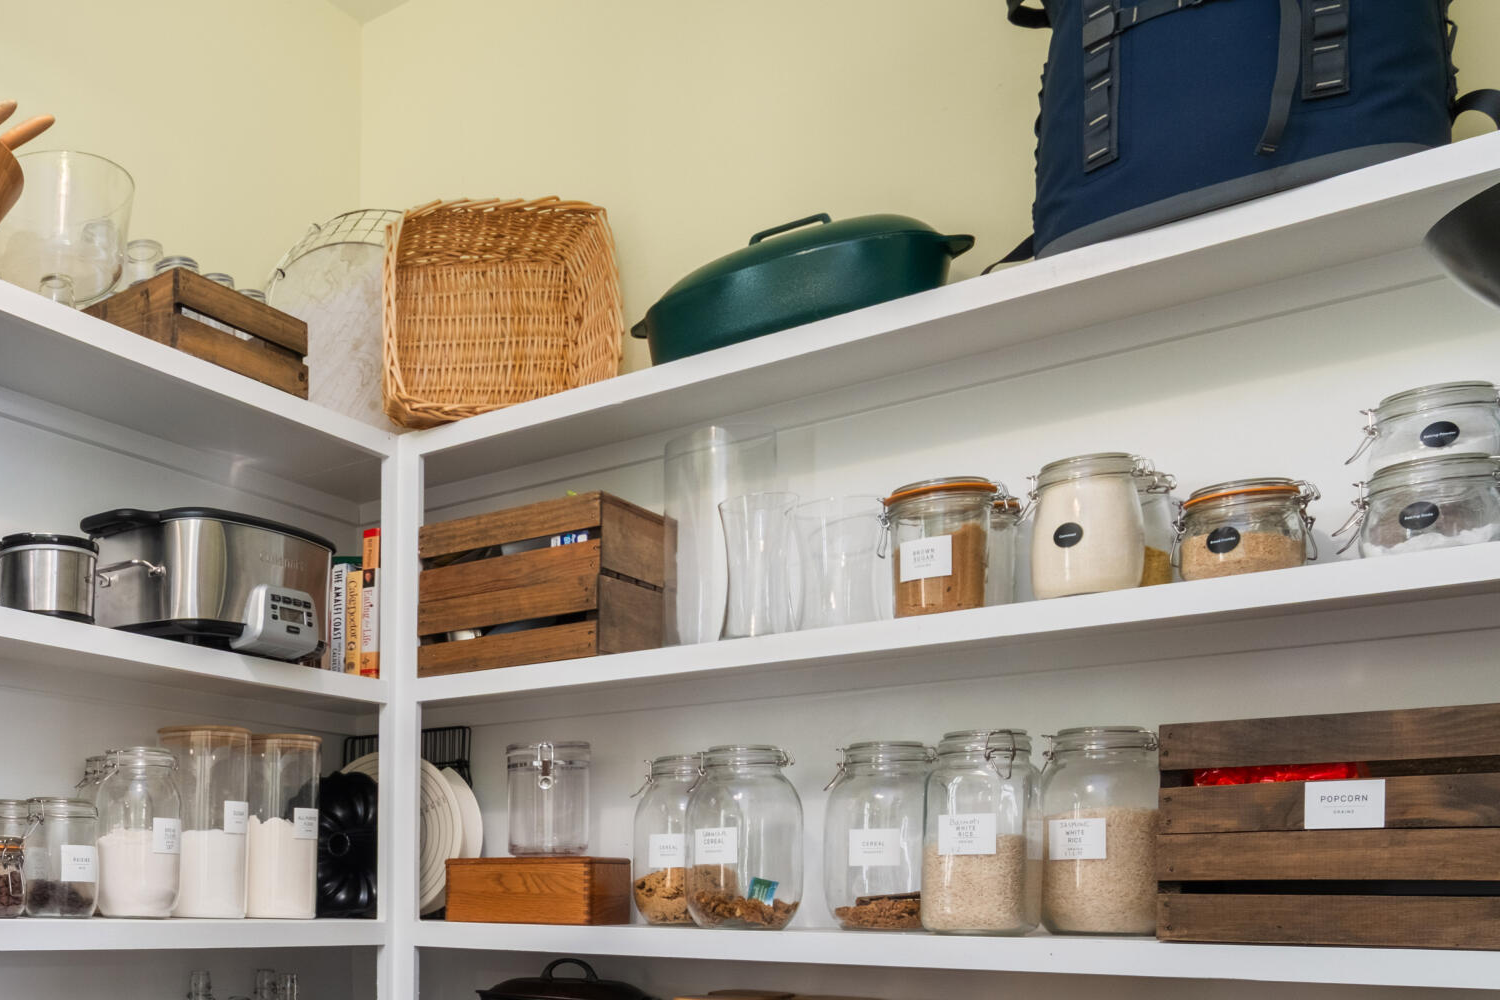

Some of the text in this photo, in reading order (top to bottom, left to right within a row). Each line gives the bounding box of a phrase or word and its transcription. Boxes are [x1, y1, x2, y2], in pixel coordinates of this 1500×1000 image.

[334, 570, 343, 583] THE
[334, 587, 343, 615] AMALFI
[363, 589, 373, 619] Eating
[333, 617, 342, 640] COAST
[363, 629, 372, 647] Life
[1320, 795, 1368, 803] POPCORN
